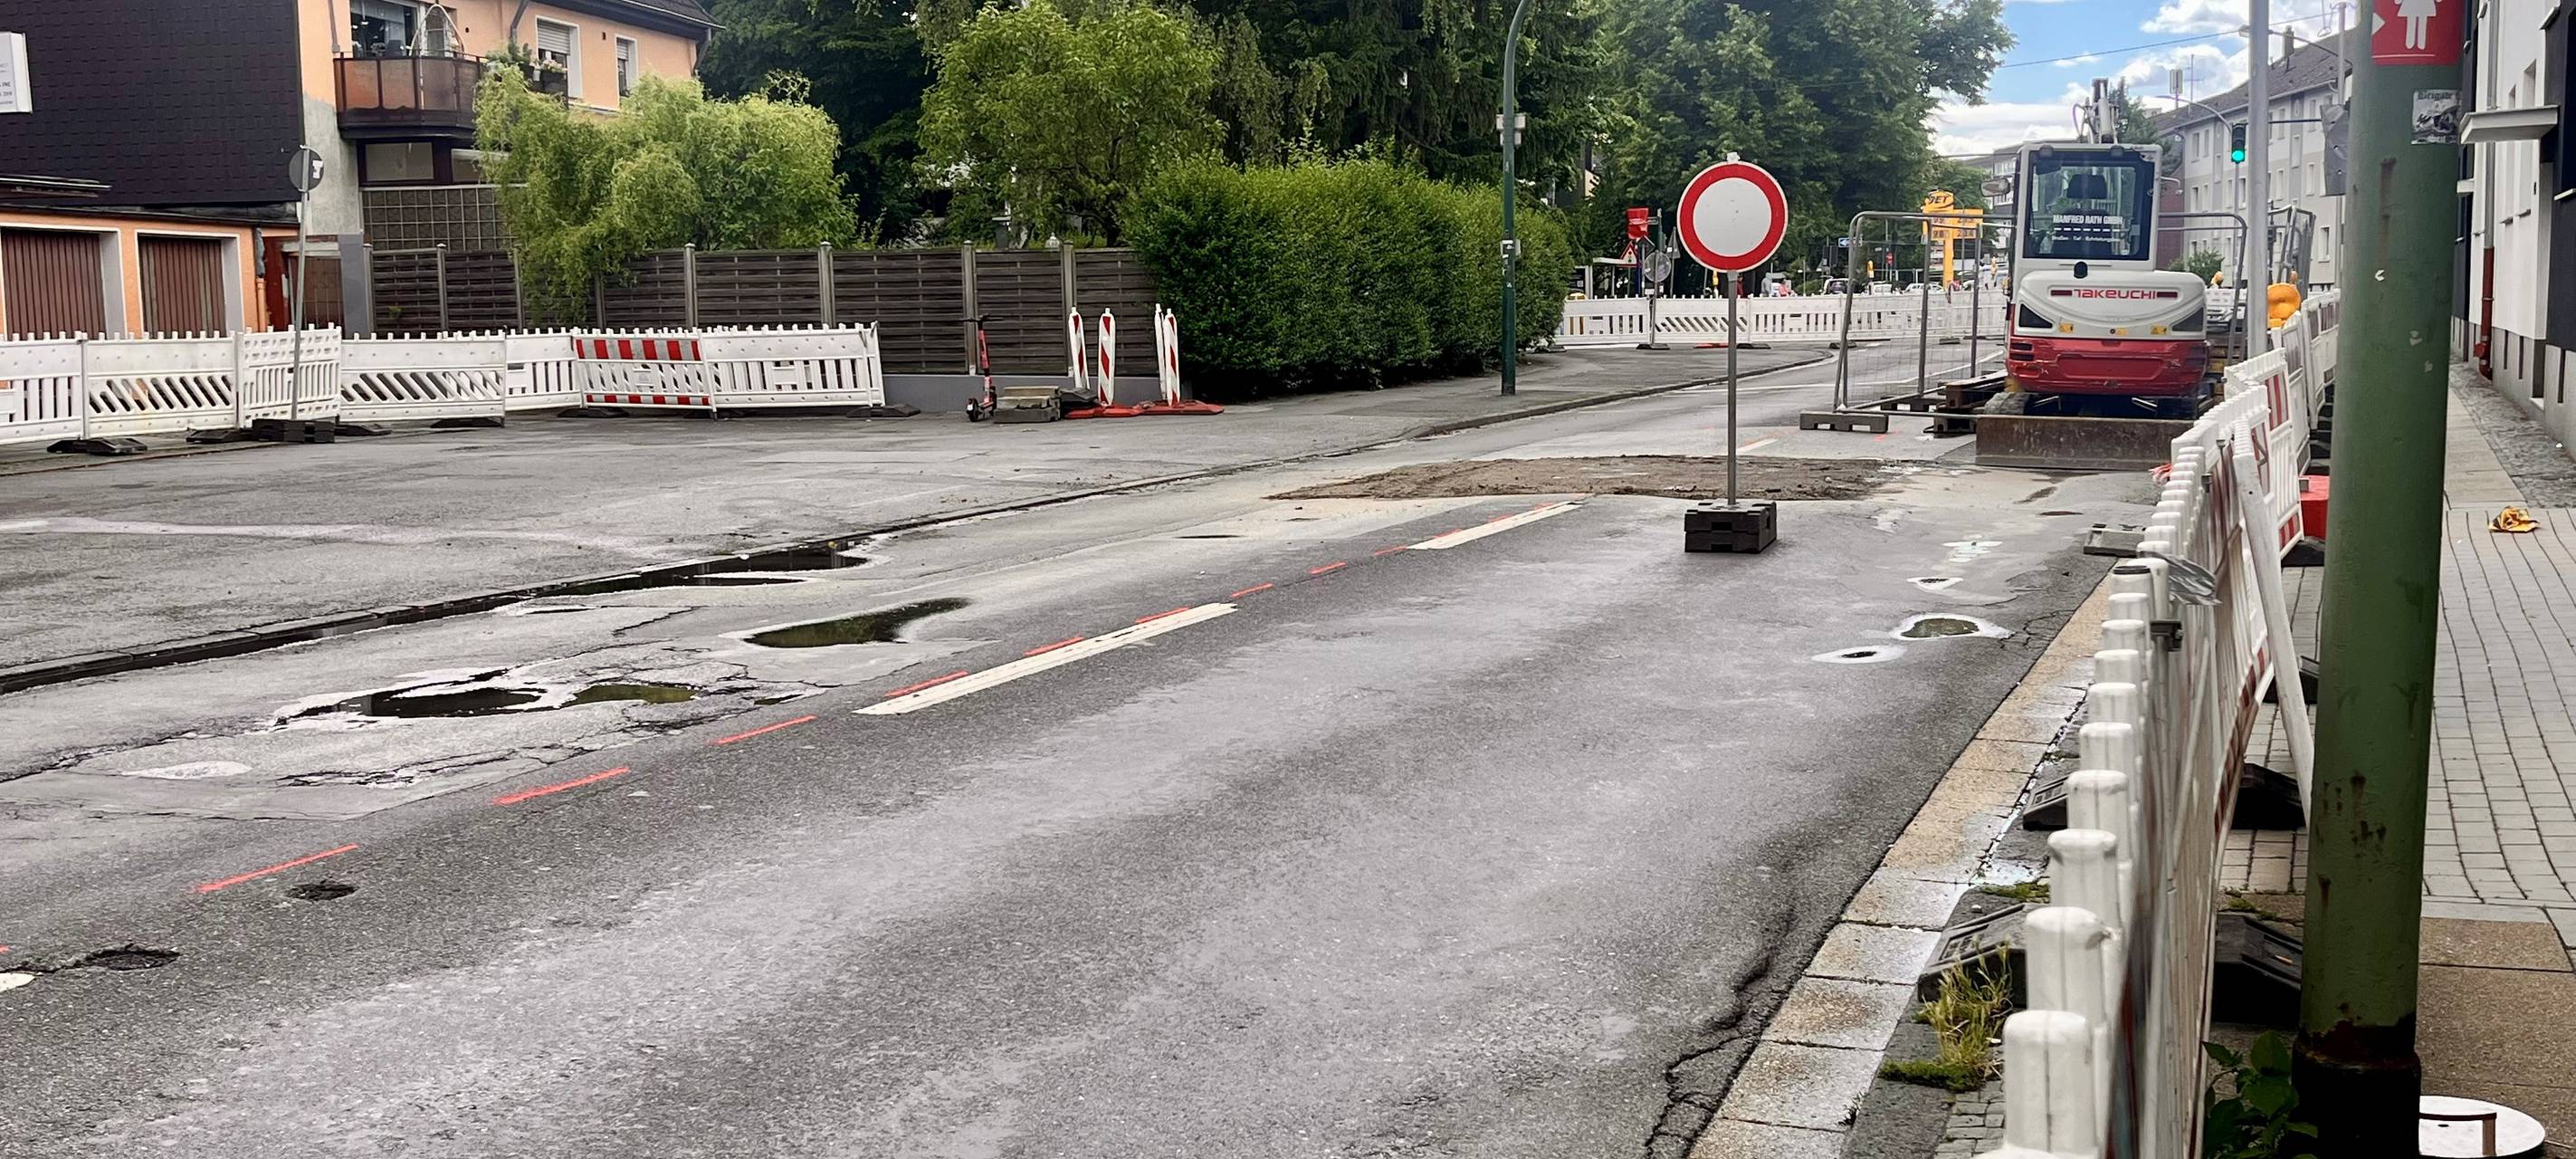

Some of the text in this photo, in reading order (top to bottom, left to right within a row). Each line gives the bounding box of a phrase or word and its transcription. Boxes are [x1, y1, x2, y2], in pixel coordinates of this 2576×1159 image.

[1929, 195, 1948, 204] JET
[2053, 215, 2084, 223] MANFRED
[2085, 216, 2102, 224] RATH
